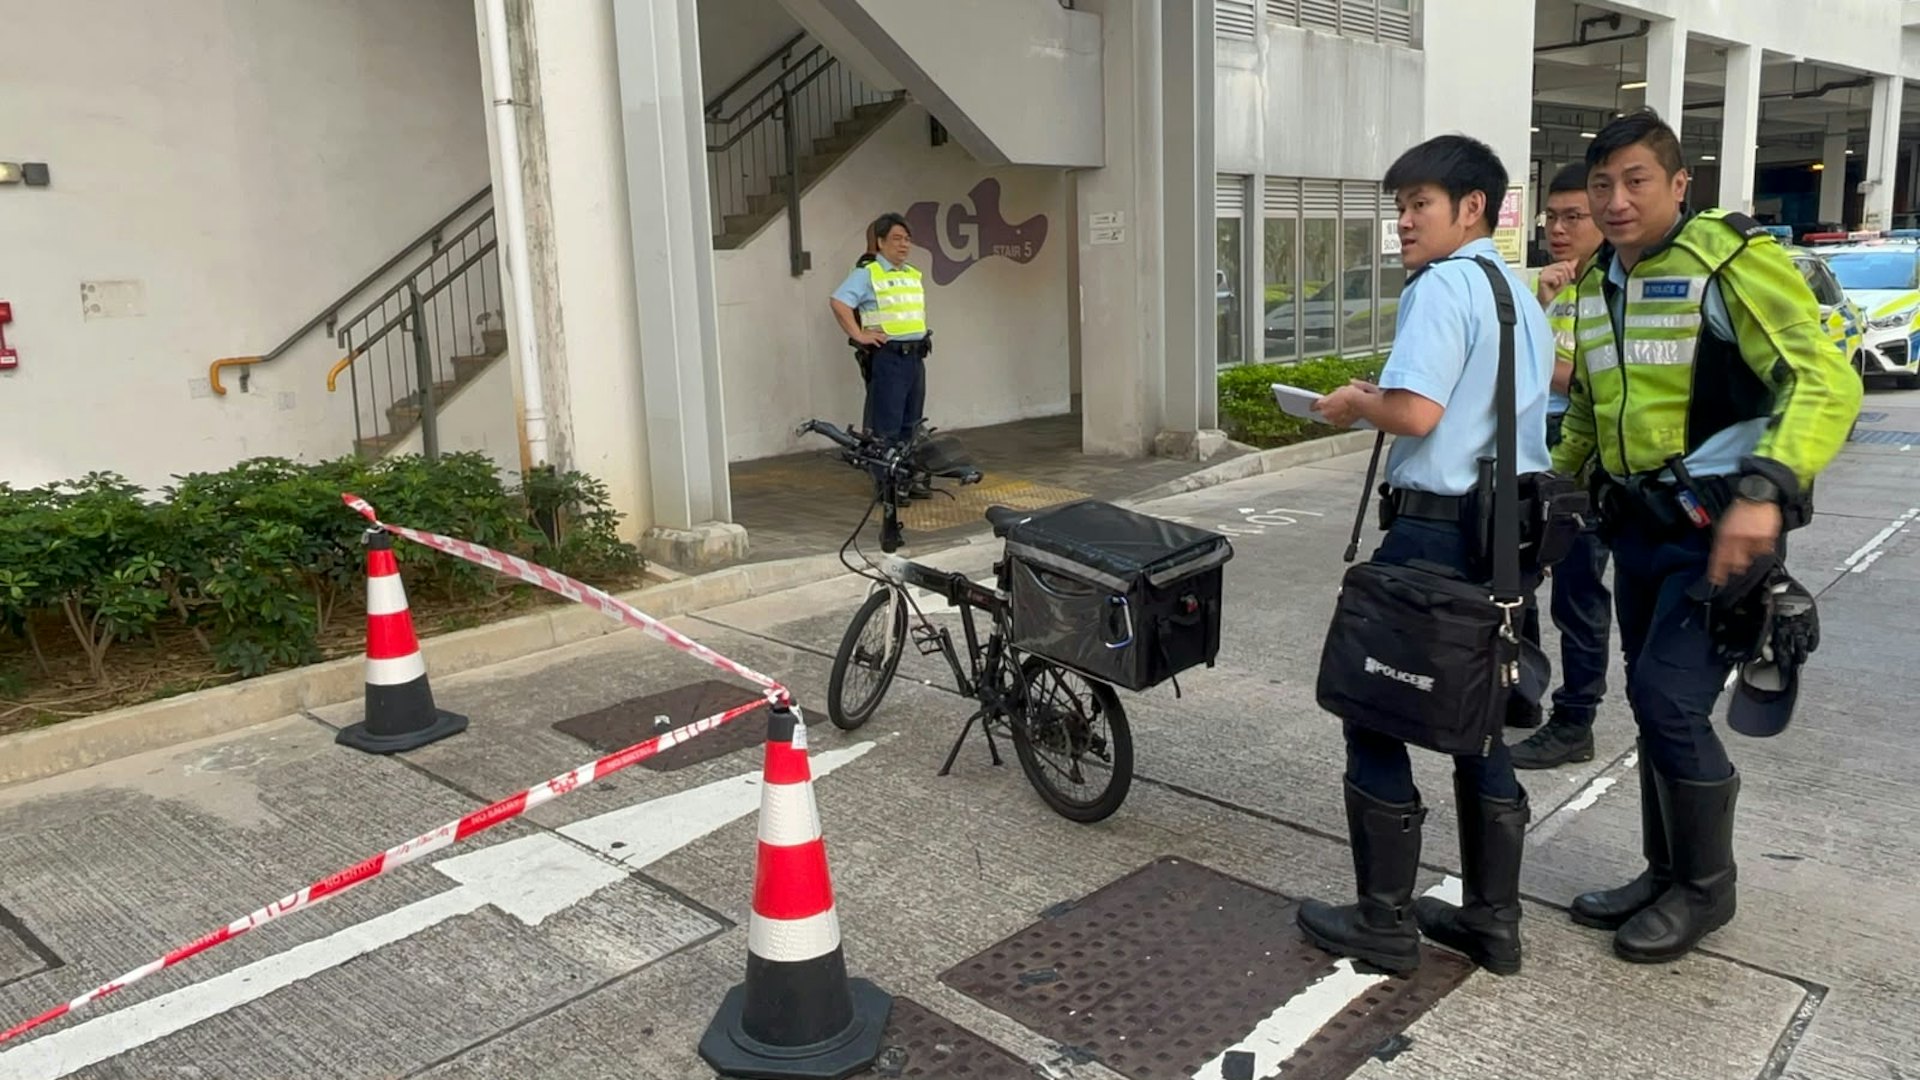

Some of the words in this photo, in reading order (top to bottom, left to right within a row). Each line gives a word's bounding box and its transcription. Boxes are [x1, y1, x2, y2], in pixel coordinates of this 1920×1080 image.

[936, 202, 982, 262] G
[993, 245, 1021, 257] STAIR
[1024, 241, 1032, 257] 5
[1375, 661, 1419, 684] POLICE
[324, 876, 340, 888] NO
[341, 861, 378, 881] ENTRY
